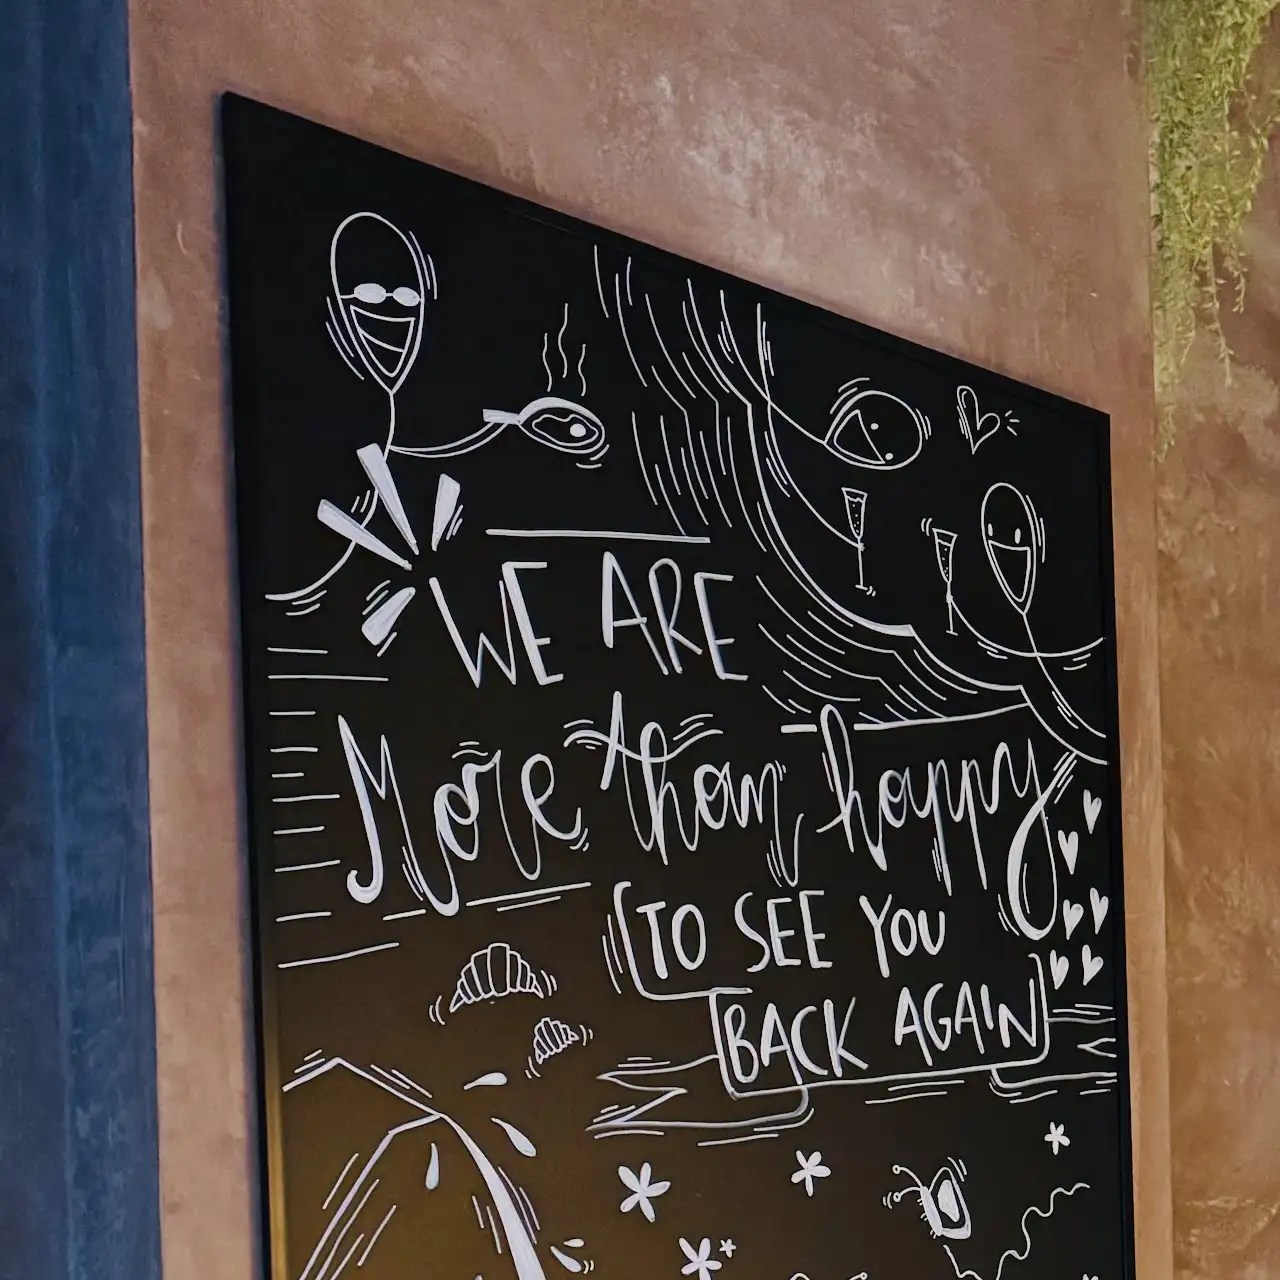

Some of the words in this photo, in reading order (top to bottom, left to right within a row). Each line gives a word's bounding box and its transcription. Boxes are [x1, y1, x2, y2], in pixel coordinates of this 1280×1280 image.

[430, 561, 562, 687] WE
[601, 551, 748, 681] ARE
[338, 715, 581, 916] More
[566, 691, 803, 886] than
[818, 704, 1060, 940] happy
[636, 901, 707, 981] TO
[736, 891, 834, 973] SEE
[859, 892, 946, 978] YOU
[724, 998, 868, 1084] BACK
[894, 987, 1037, 1067] AGAIN
